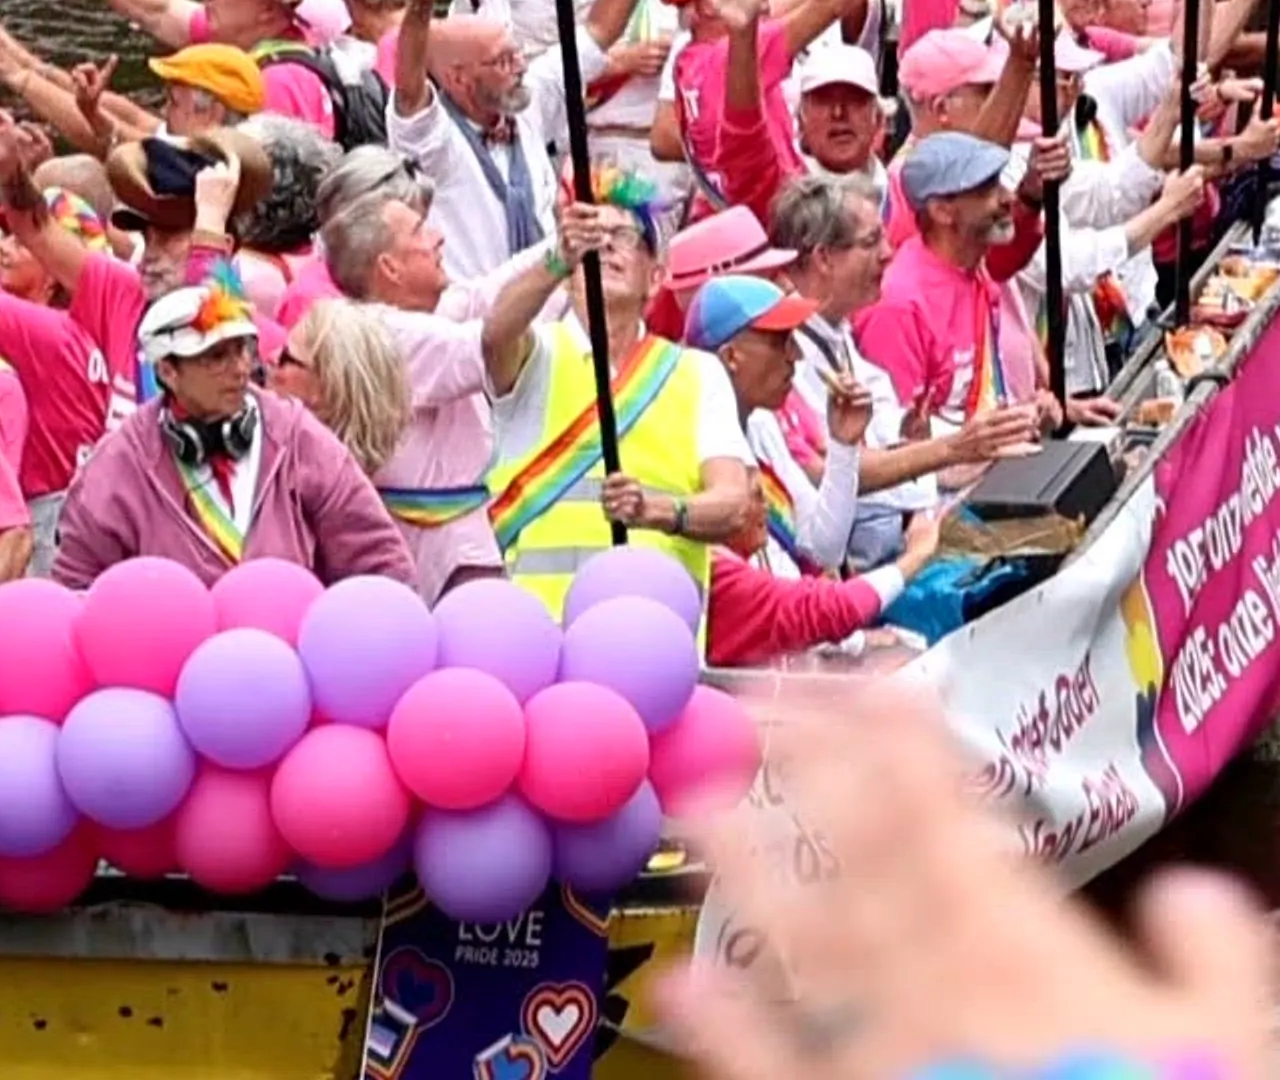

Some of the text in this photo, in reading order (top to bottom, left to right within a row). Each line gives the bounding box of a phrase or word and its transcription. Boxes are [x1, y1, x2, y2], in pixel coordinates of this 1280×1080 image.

[1218, 589, 1275, 679] onze
[458, 910, 545, 946] LOVE
[454, 945, 500, 967] PRIDE
